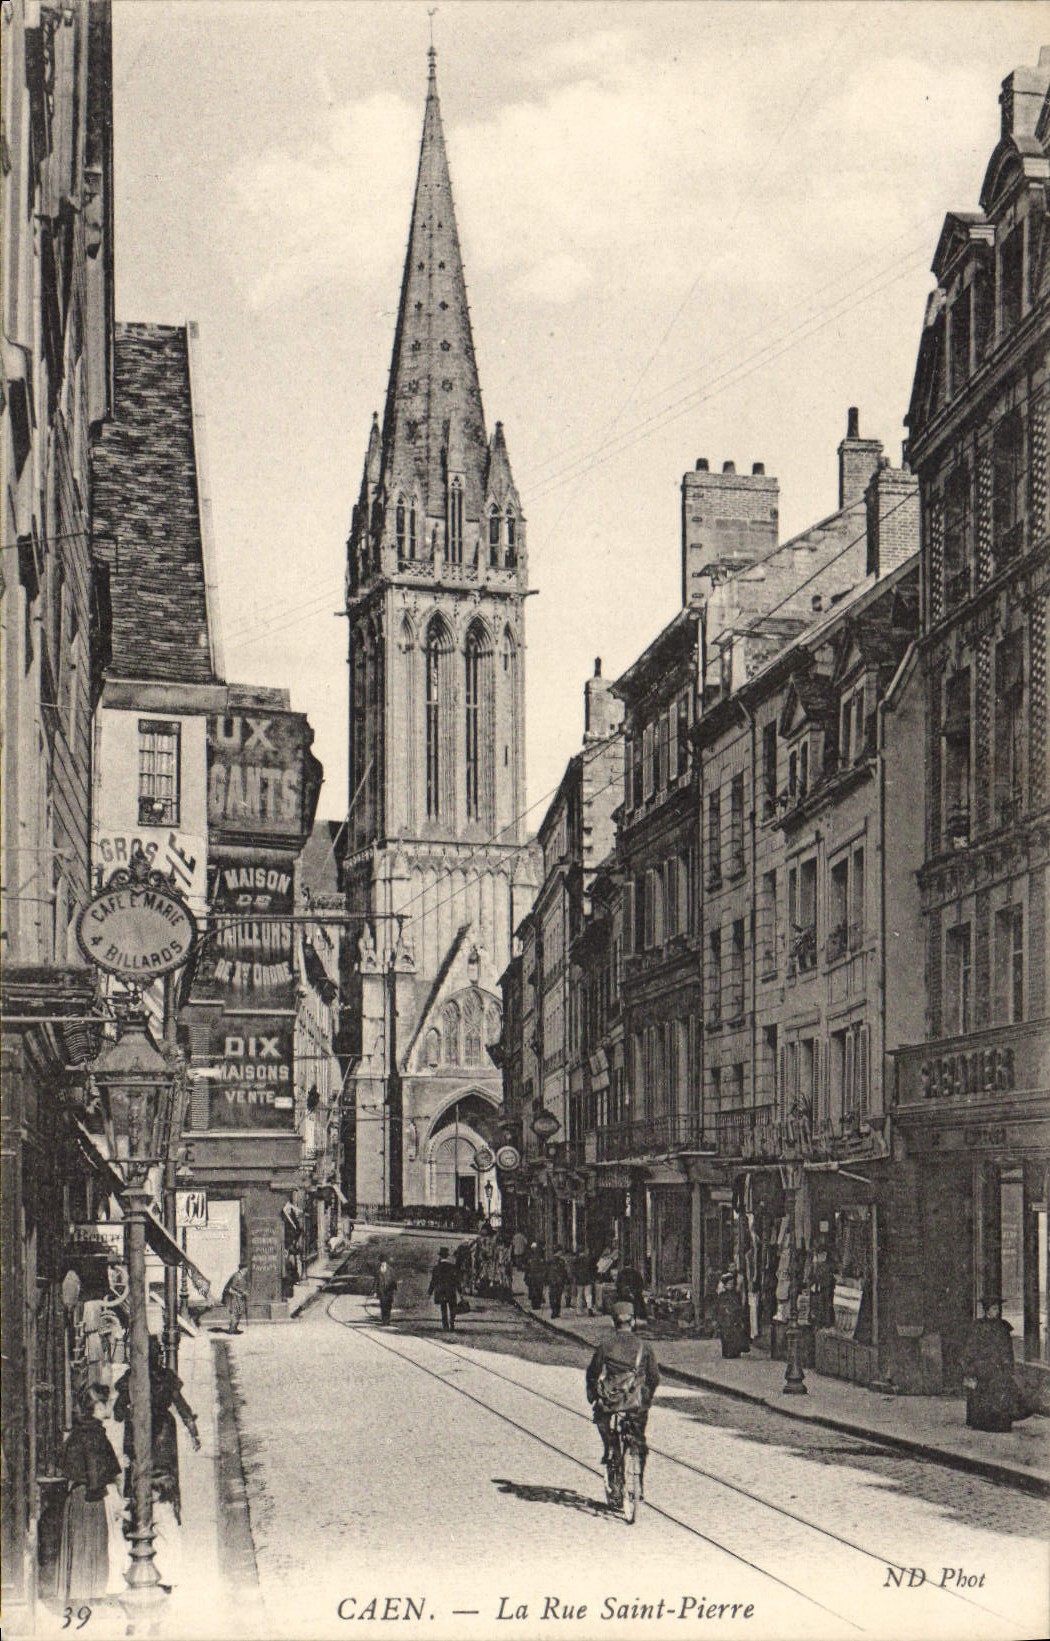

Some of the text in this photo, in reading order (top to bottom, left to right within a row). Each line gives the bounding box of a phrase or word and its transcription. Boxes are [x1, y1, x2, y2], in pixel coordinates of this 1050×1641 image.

[224, 868, 291, 895] MAISON
[143, 892, 185, 927] MARIE
[236, 893, 272, 908] DE
[215, 912, 291, 951] TAILLEURS
[104, 940, 183, 968] BILLARDS
[253, 961, 293, 988] ORDRE
[225, 1036, 281, 1057] DIX
[215, 1064, 290, 1081] MAISONS
[225, 1090, 275, 1104] VENTE
